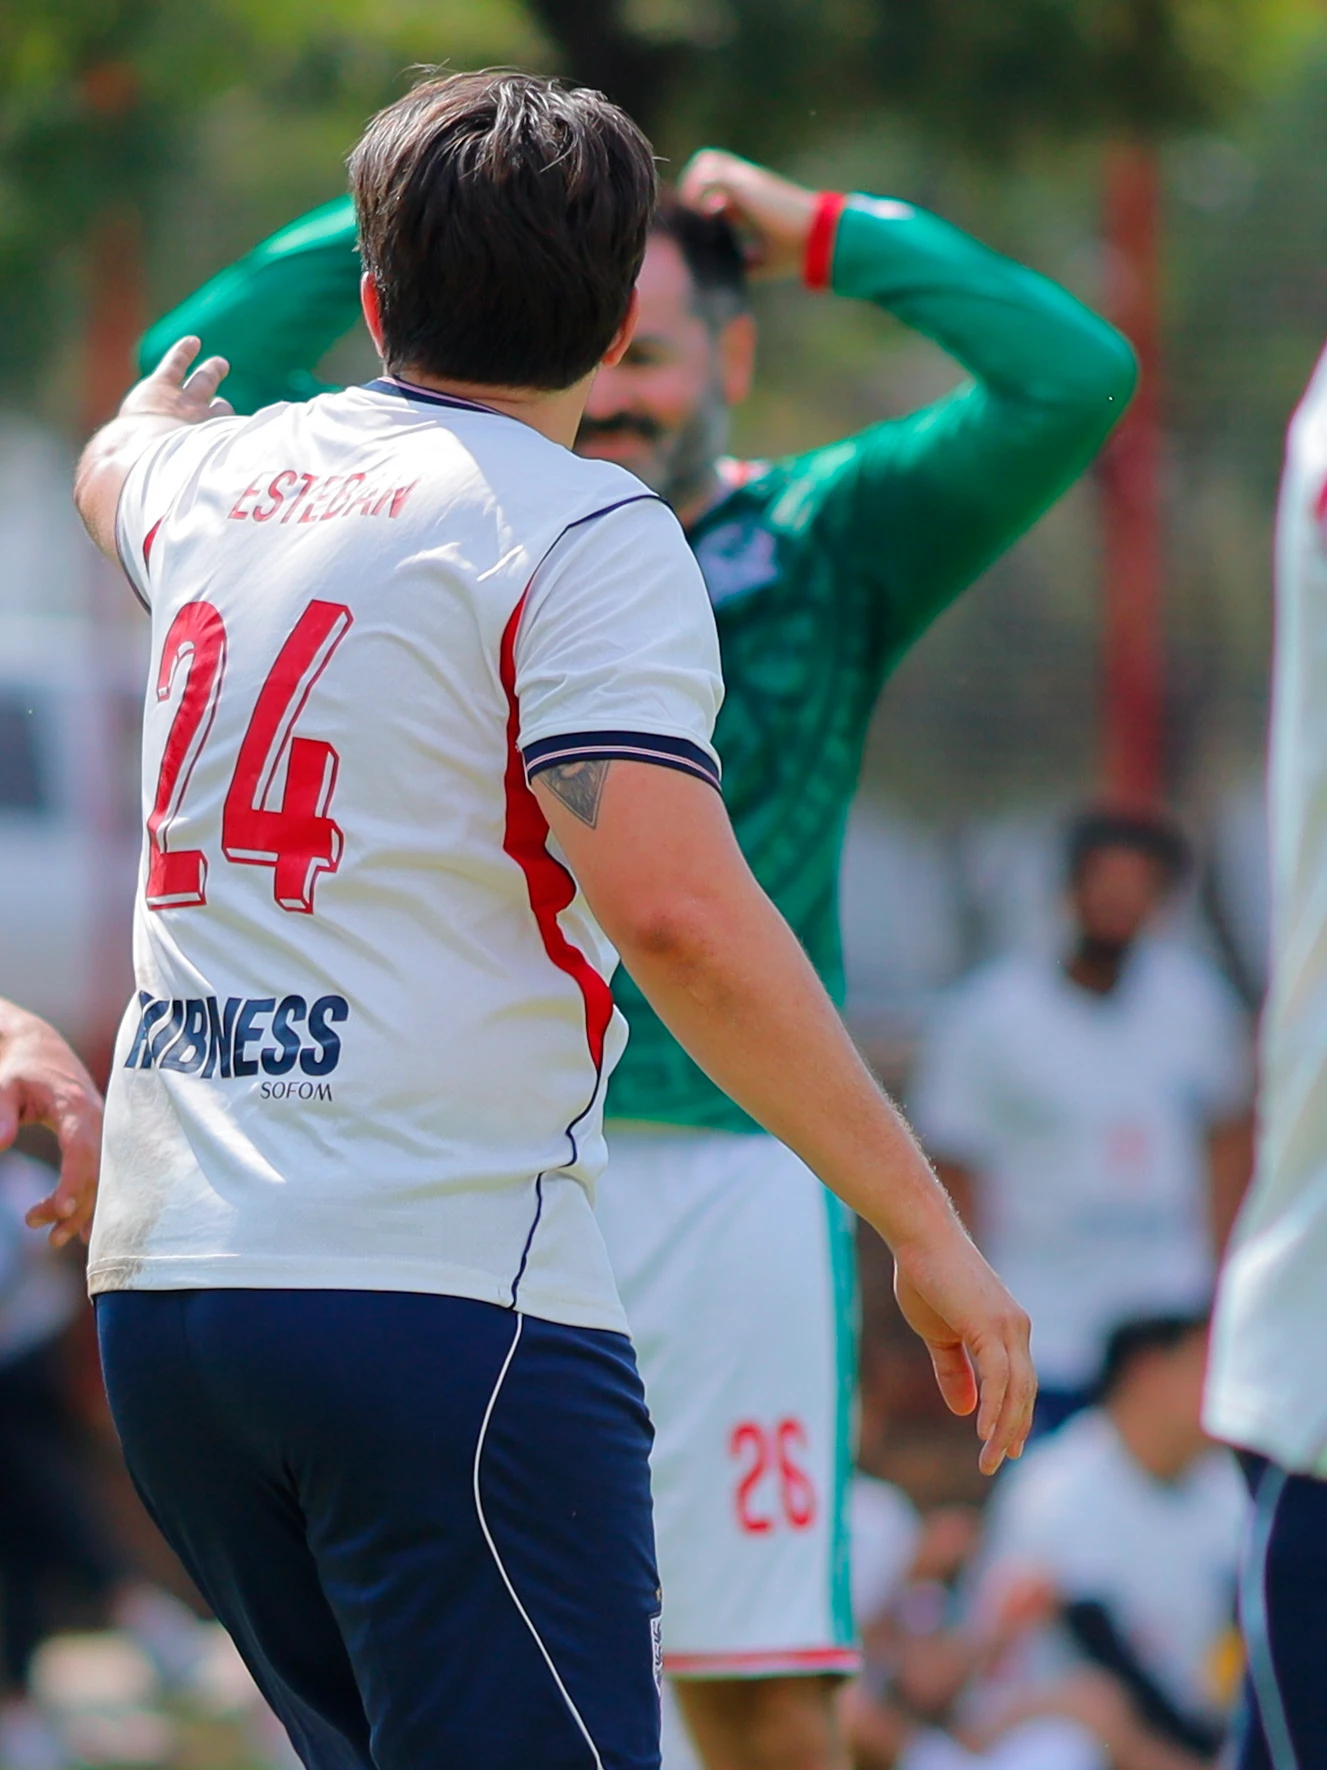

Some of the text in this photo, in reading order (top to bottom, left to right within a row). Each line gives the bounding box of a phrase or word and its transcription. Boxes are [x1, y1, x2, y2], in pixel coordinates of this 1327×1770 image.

[146, 599, 354, 914] 24
[260, 1081, 333, 1101] SOFOM
[729, 1418, 817, 1536] 26
